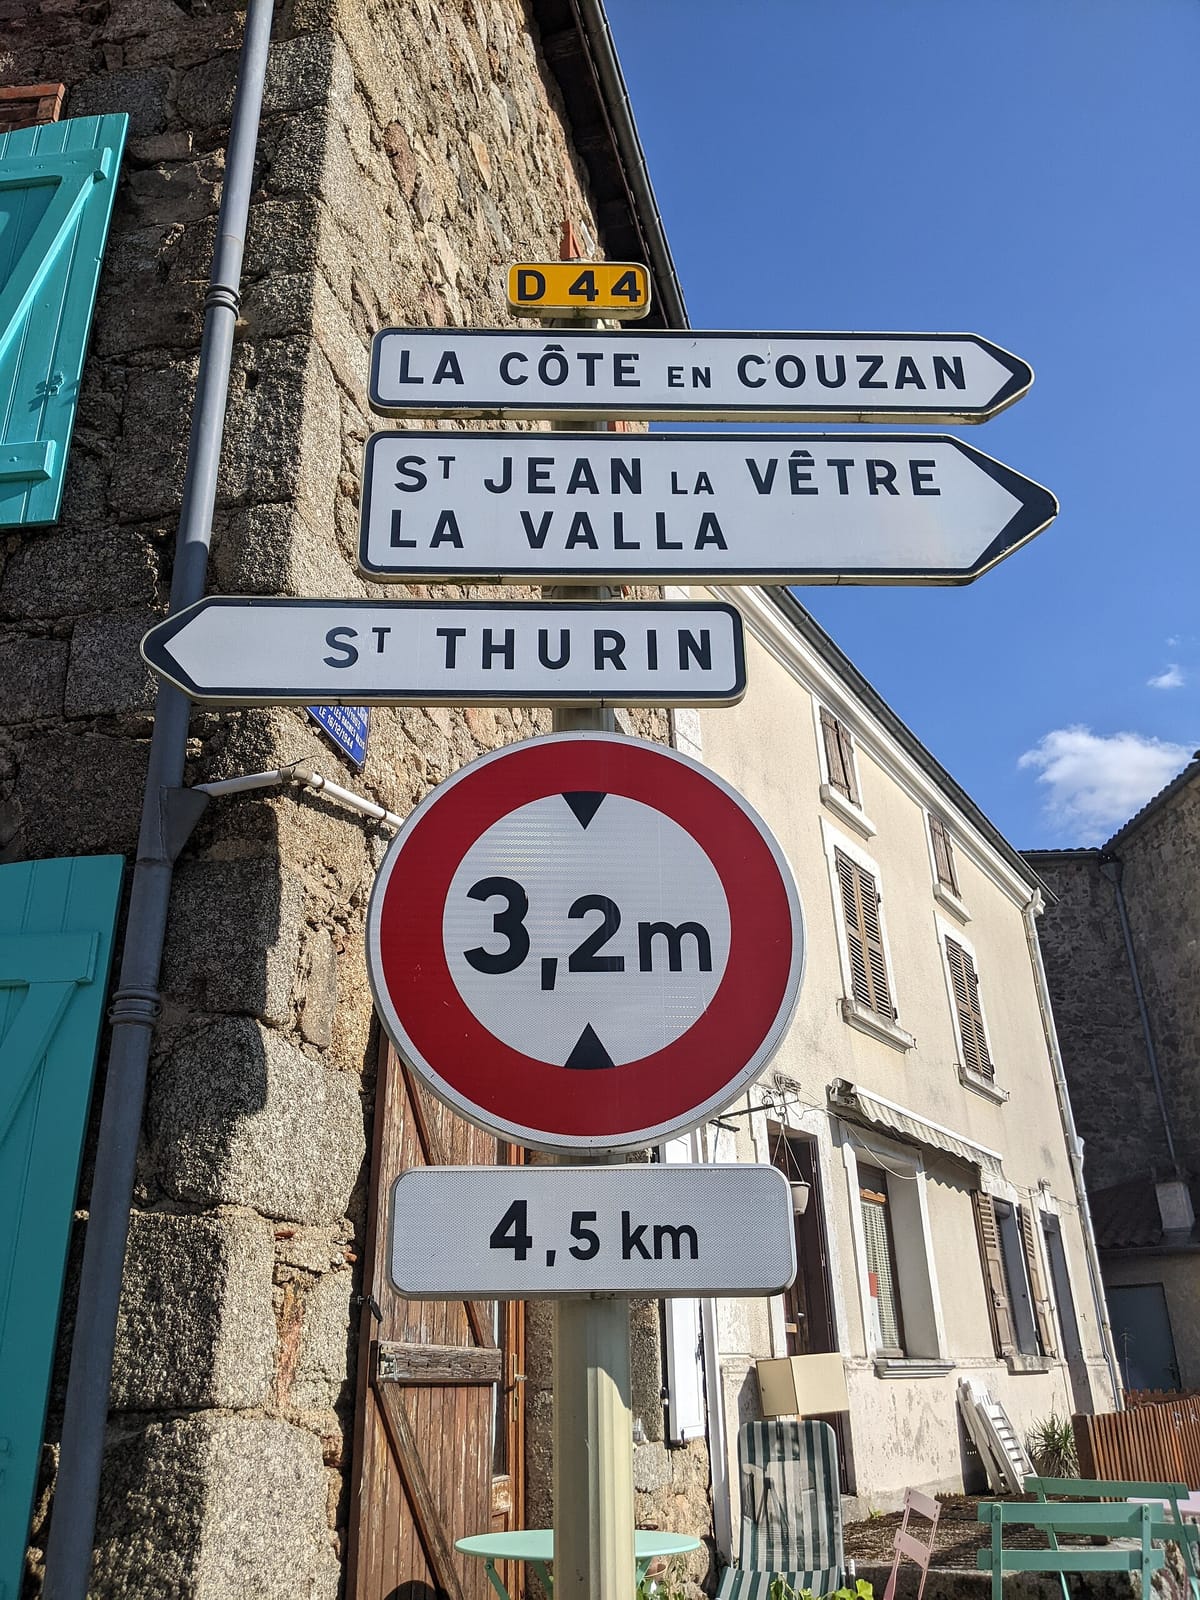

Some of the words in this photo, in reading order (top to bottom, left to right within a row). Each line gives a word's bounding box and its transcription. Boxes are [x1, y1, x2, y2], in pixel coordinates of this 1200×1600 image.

[517, 269, 547, 302] D
[568, 269, 642, 303] 44
[399, 350, 465, 385] LA
[499, 344, 641, 387] CÔTE
[667, 366, 712, 389] EN
[737, 354, 967, 390] COUZAN
[483, 456, 642, 495] JEAN
[670, 471, 715, 495] LA
[744, 449, 941, 496] VÊTRE
[389, 509, 465, 549] LA
[519, 510, 729, 551] VALLA
[436, 627, 712, 671] THURIN
[319, 706, 327, 719] LE
[462, 876, 713, 991] 3,2m
[489, 1199, 601, 1267] 4,5
[621, 1210, 699, 1261] km
